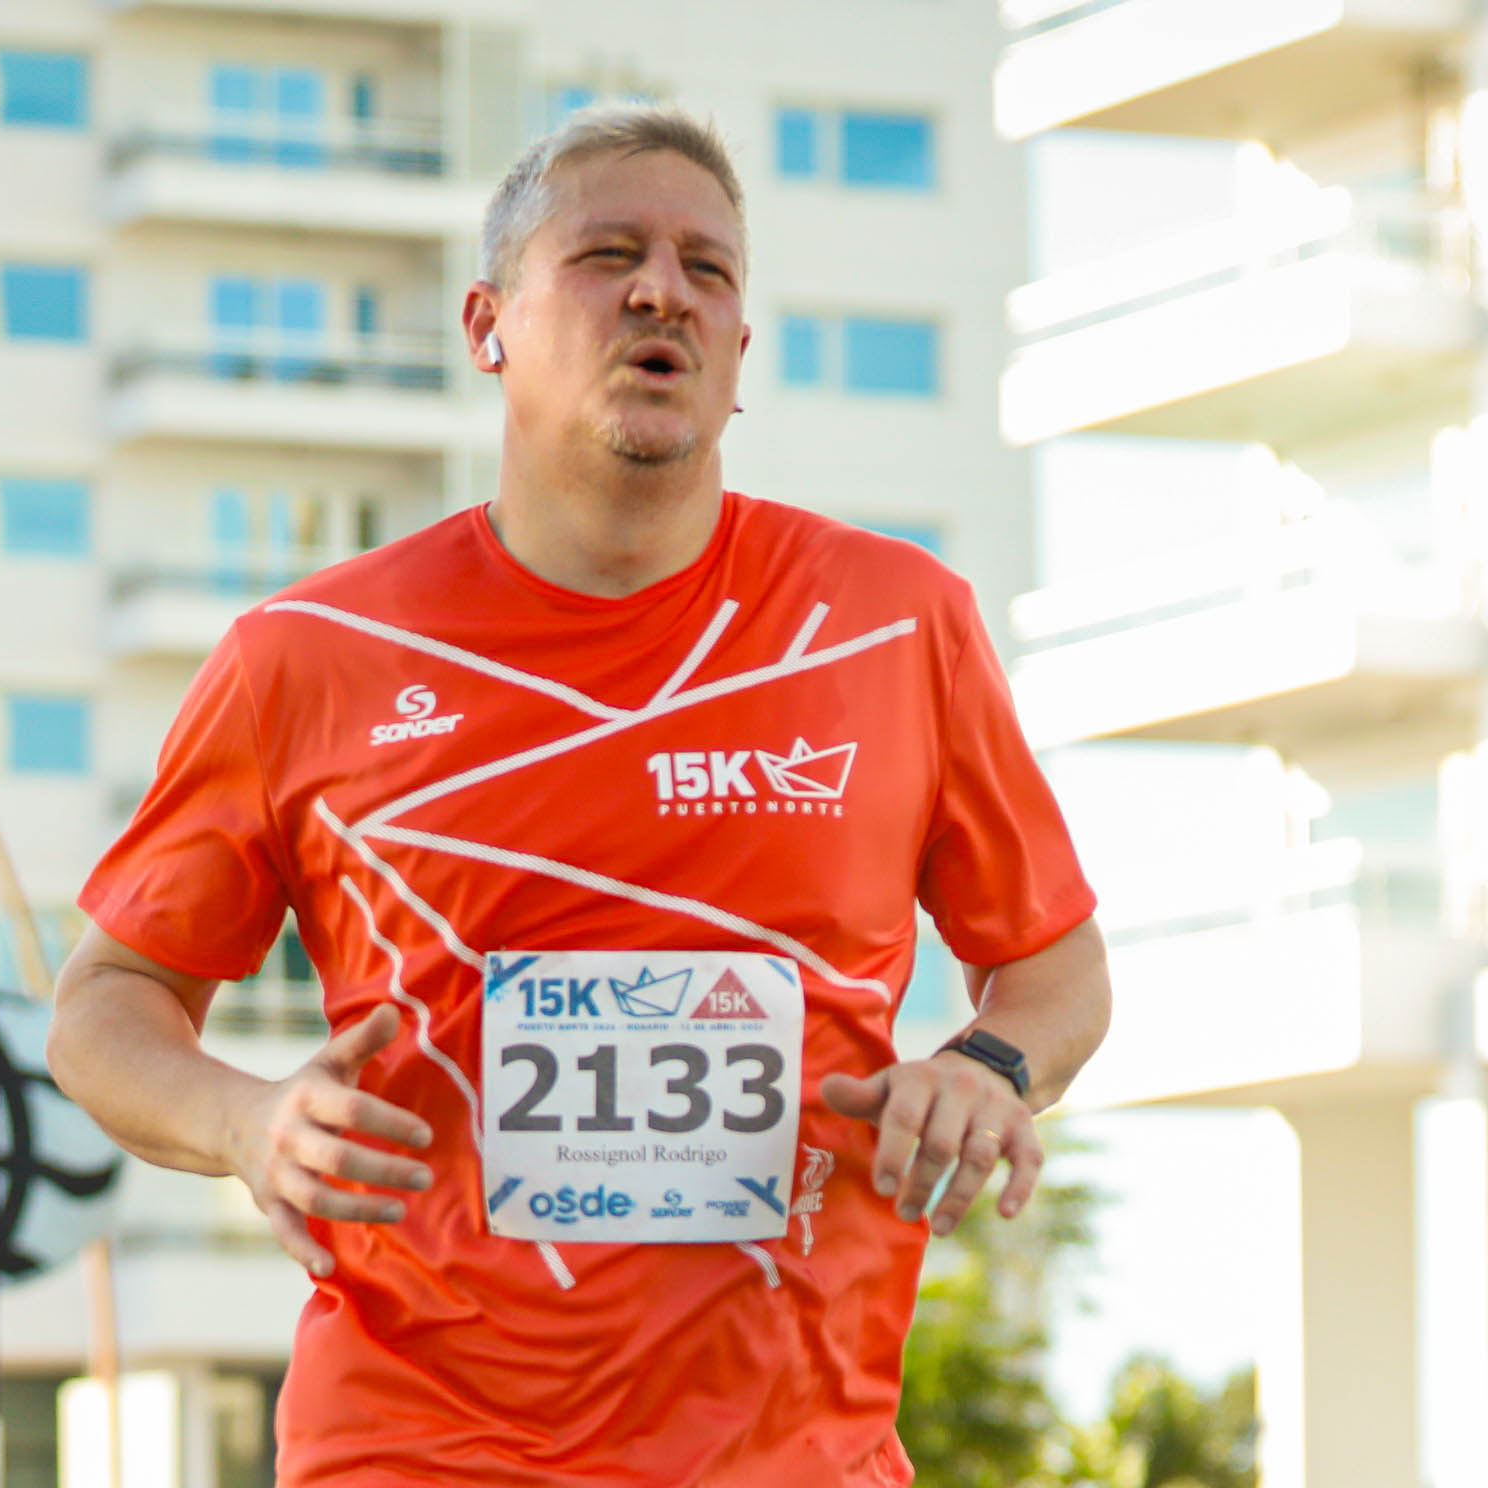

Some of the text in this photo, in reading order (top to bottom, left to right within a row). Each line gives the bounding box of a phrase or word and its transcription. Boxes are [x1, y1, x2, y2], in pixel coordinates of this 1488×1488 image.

[647, 750, 757, 801] 15K
[659, 801, 844, 818] PUERTO NORTE
[517, 978, 601, 1018] 15K
[707, 991, 751, 1014] 15K
[498, 1043, 786, 1134] 2133
[557, 1145, 728, 1166] Rossignol Rodrigo
